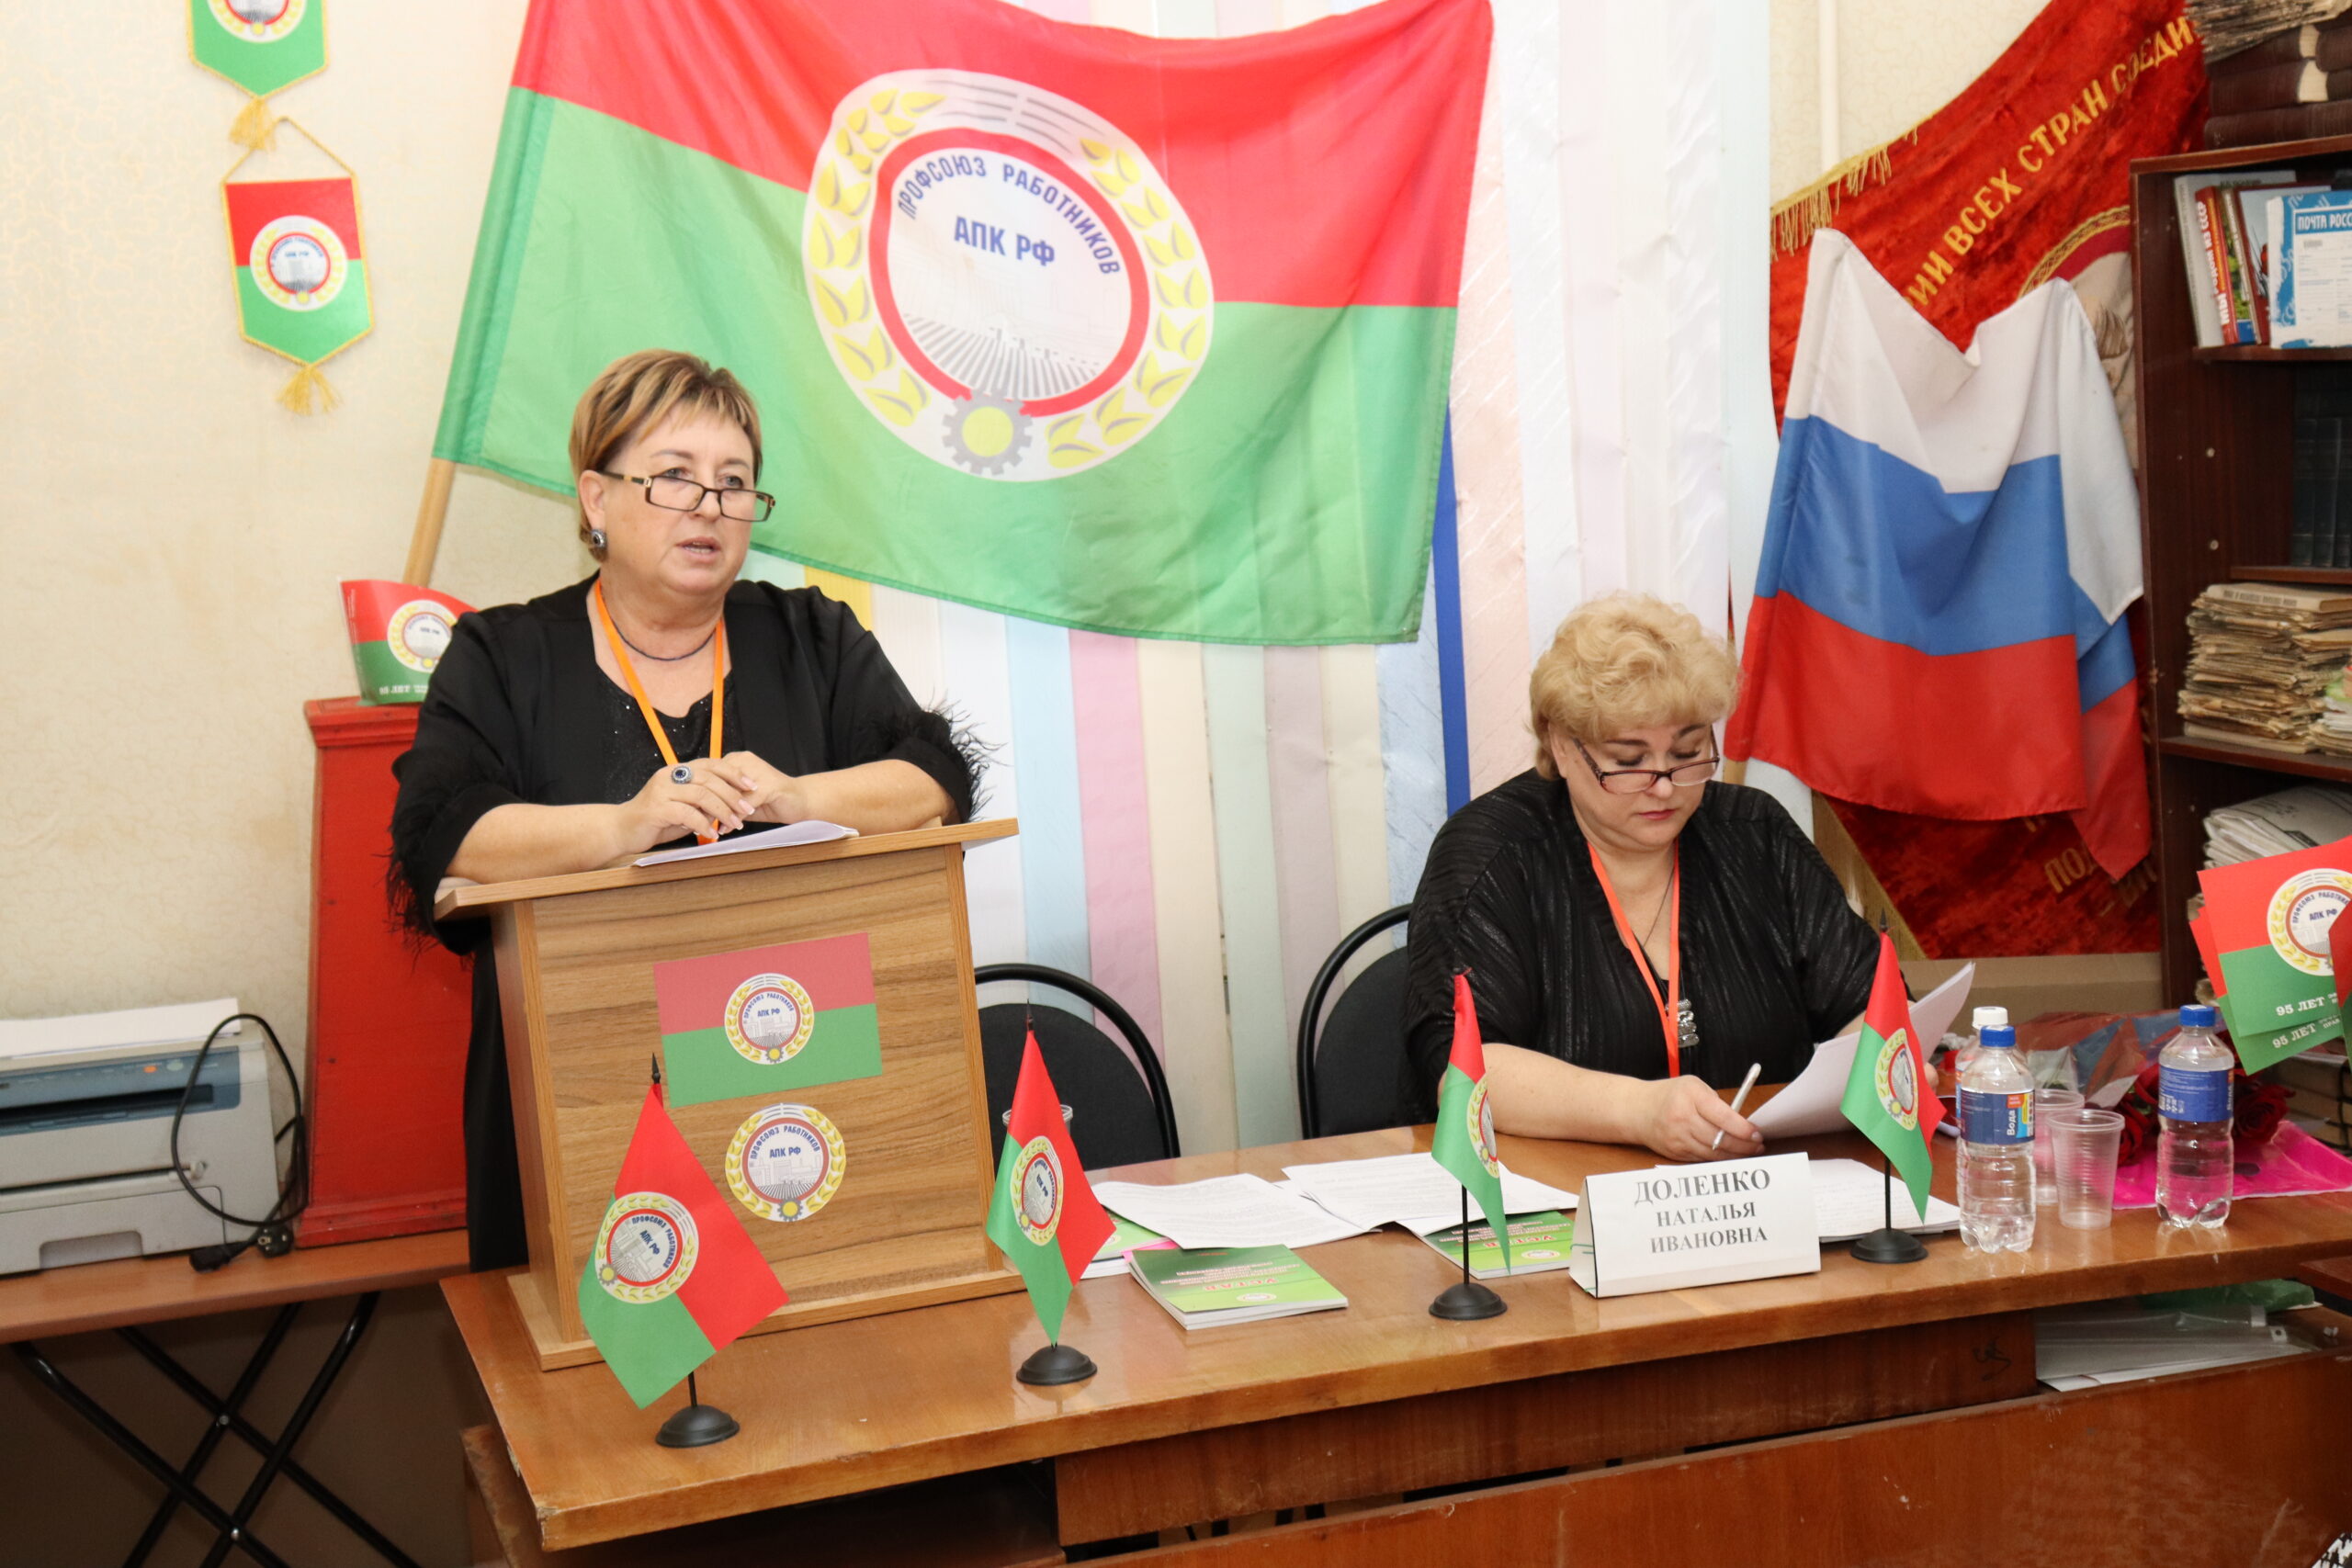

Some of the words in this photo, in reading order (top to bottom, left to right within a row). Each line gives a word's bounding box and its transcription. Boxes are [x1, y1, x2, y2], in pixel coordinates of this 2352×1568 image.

[1903, 250, 1954, 306] ИИ
[1944, 167, 2022, 255] ВСЕХ
[2019, 79, 2110, 174] СТРАН
[2110, 16, 2198, 94] СОЕДИ
[897, 154, 988, 220] ПРОФСОЮЗ
[1002, 163, 1121, 275] РАБОТНИКОВ
[2298, 215, 2327, 231] ПОЧТА
[954, 215, 1007, 258] АПК
[1015, 233, 1056, 266] РФ
[2276, 1003, 2294, 1016] 95
[2298, 996, 2325, 1012] ЛЕТ
[2272, 1034, 2289, 1049] 95
[2290, 1022, 2316, 1042] ЛЕТ
[2007, 1110, 2018, 1136] Вода
[750, 1126, 780, 1160] ПРОФСОЮЗ
[784, 1125, 820, 1152] РАБОТНИКОВ
[769, 1147, 786, 1158] АПК
[788, 1145, 801, 1156] РФ
[1634, 1168, 1771, 1207] ДОЛЕНКО
[1656, 1201, 1757, 1228] НАТАЛЬЯ
[639, 1229, 654, 1246] АПК
[649, 1242, 661, 1255] РФ
[1650, 1225, 1768, 1254] ИВАНОВНА
